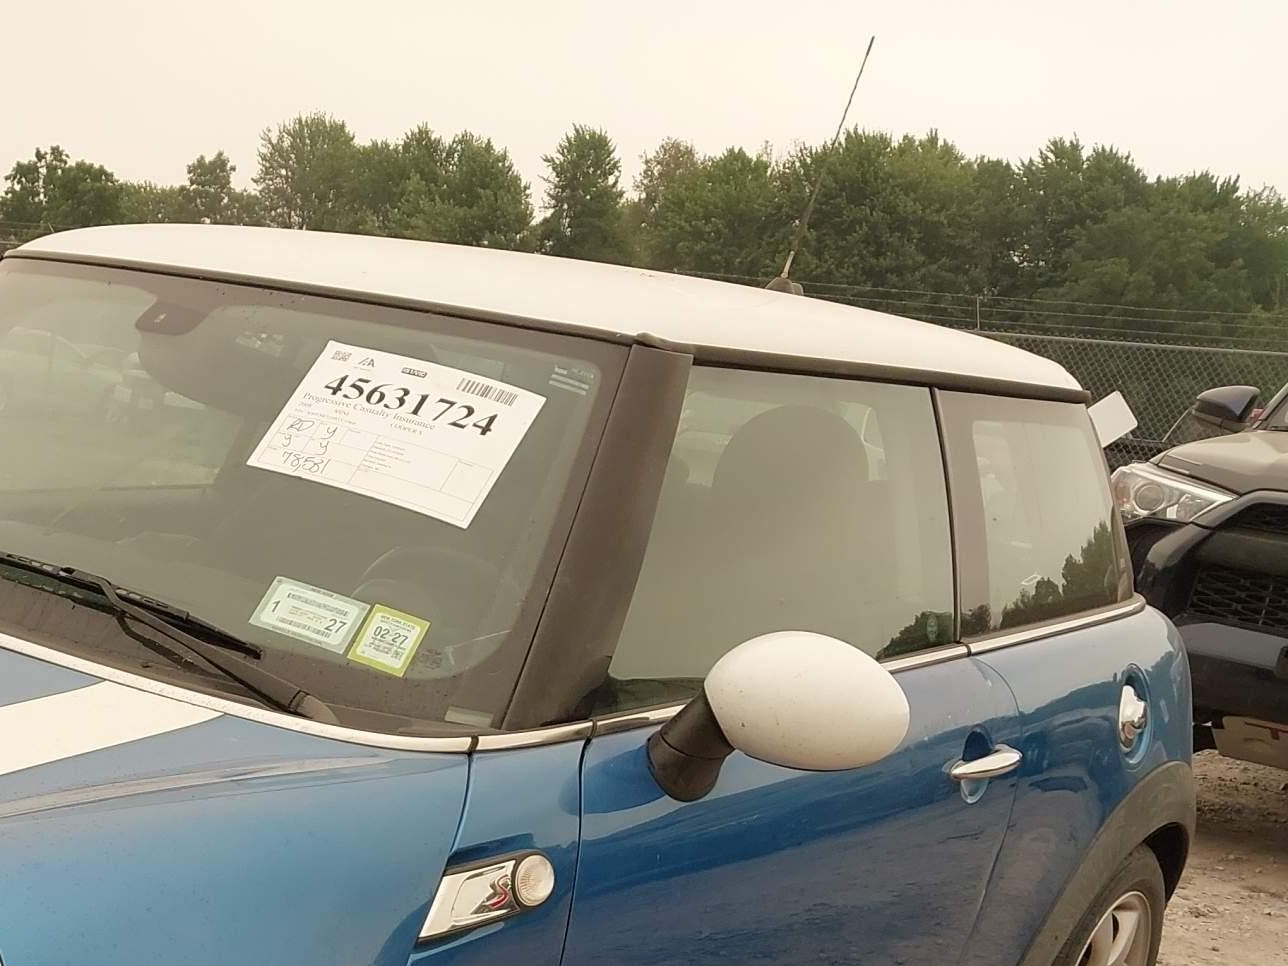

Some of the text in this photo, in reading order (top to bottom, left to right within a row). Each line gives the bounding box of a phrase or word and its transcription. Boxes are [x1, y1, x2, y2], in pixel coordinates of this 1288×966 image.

[303, 391, 352, 409] Progressive
[352, 403, 389, 418] Casualty
[392, 412, 436, 430] Insurance
[324, 374, 498, 435] 45631724
[271, 600, 281, 613] 1
[324, 618, 348, 633] 27
